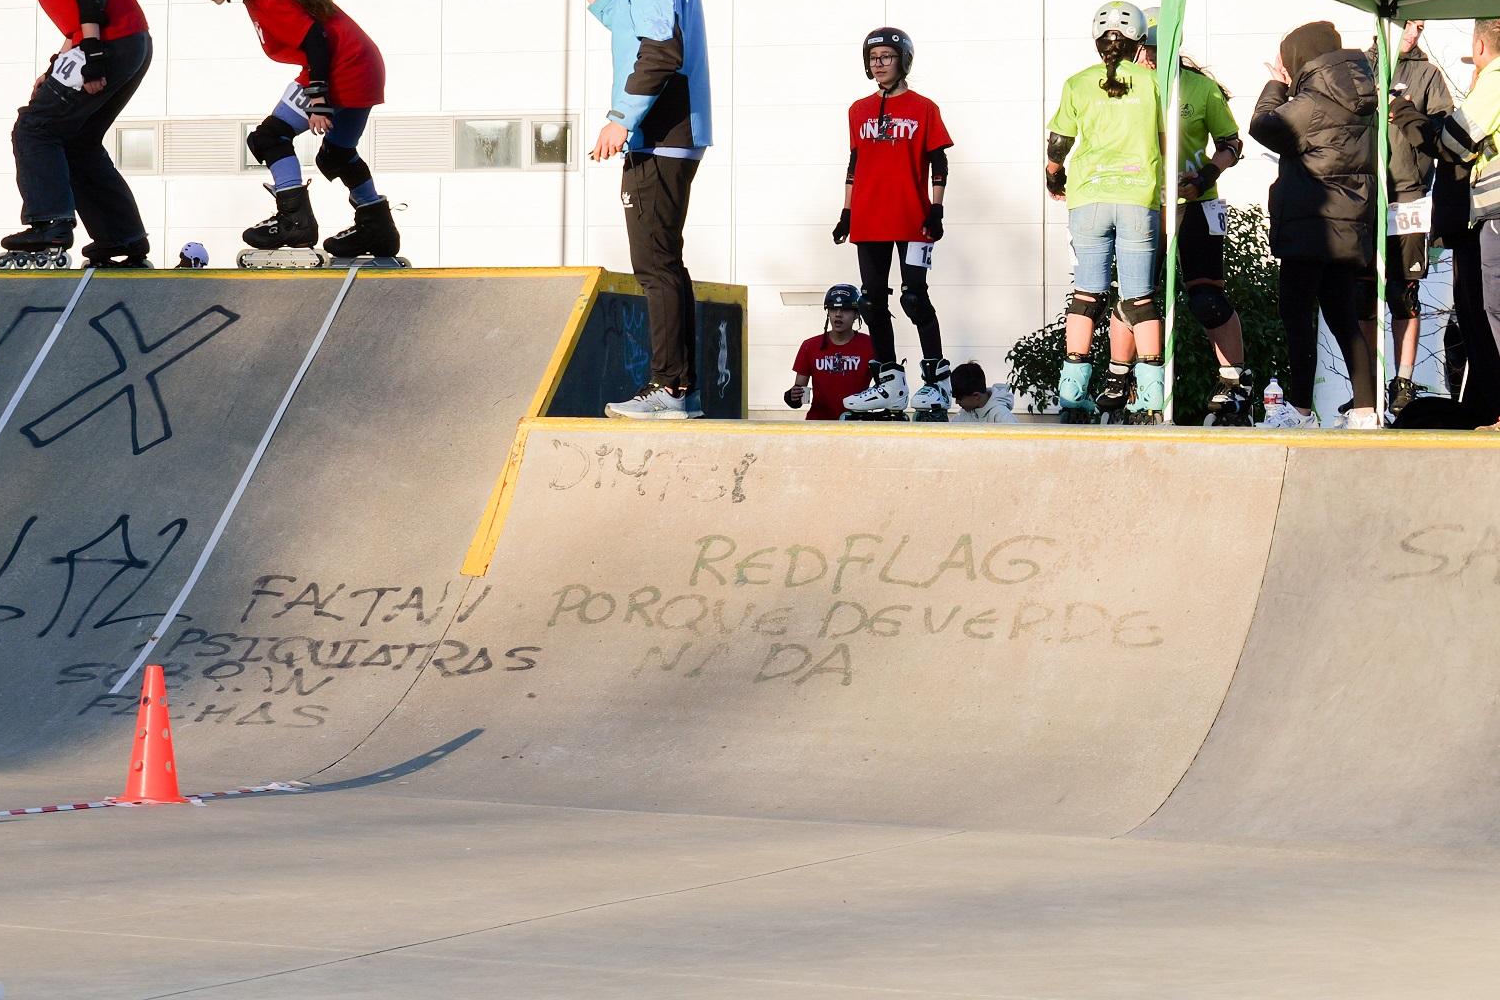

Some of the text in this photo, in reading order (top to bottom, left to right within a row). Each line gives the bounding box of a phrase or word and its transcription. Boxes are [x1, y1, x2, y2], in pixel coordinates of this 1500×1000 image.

[55, 56, 77, 81] 14
[288, 84, 311, 110] 15
[1397, 211, 1422, 230] 84
[546, 583, 790, 639] PORQUE
